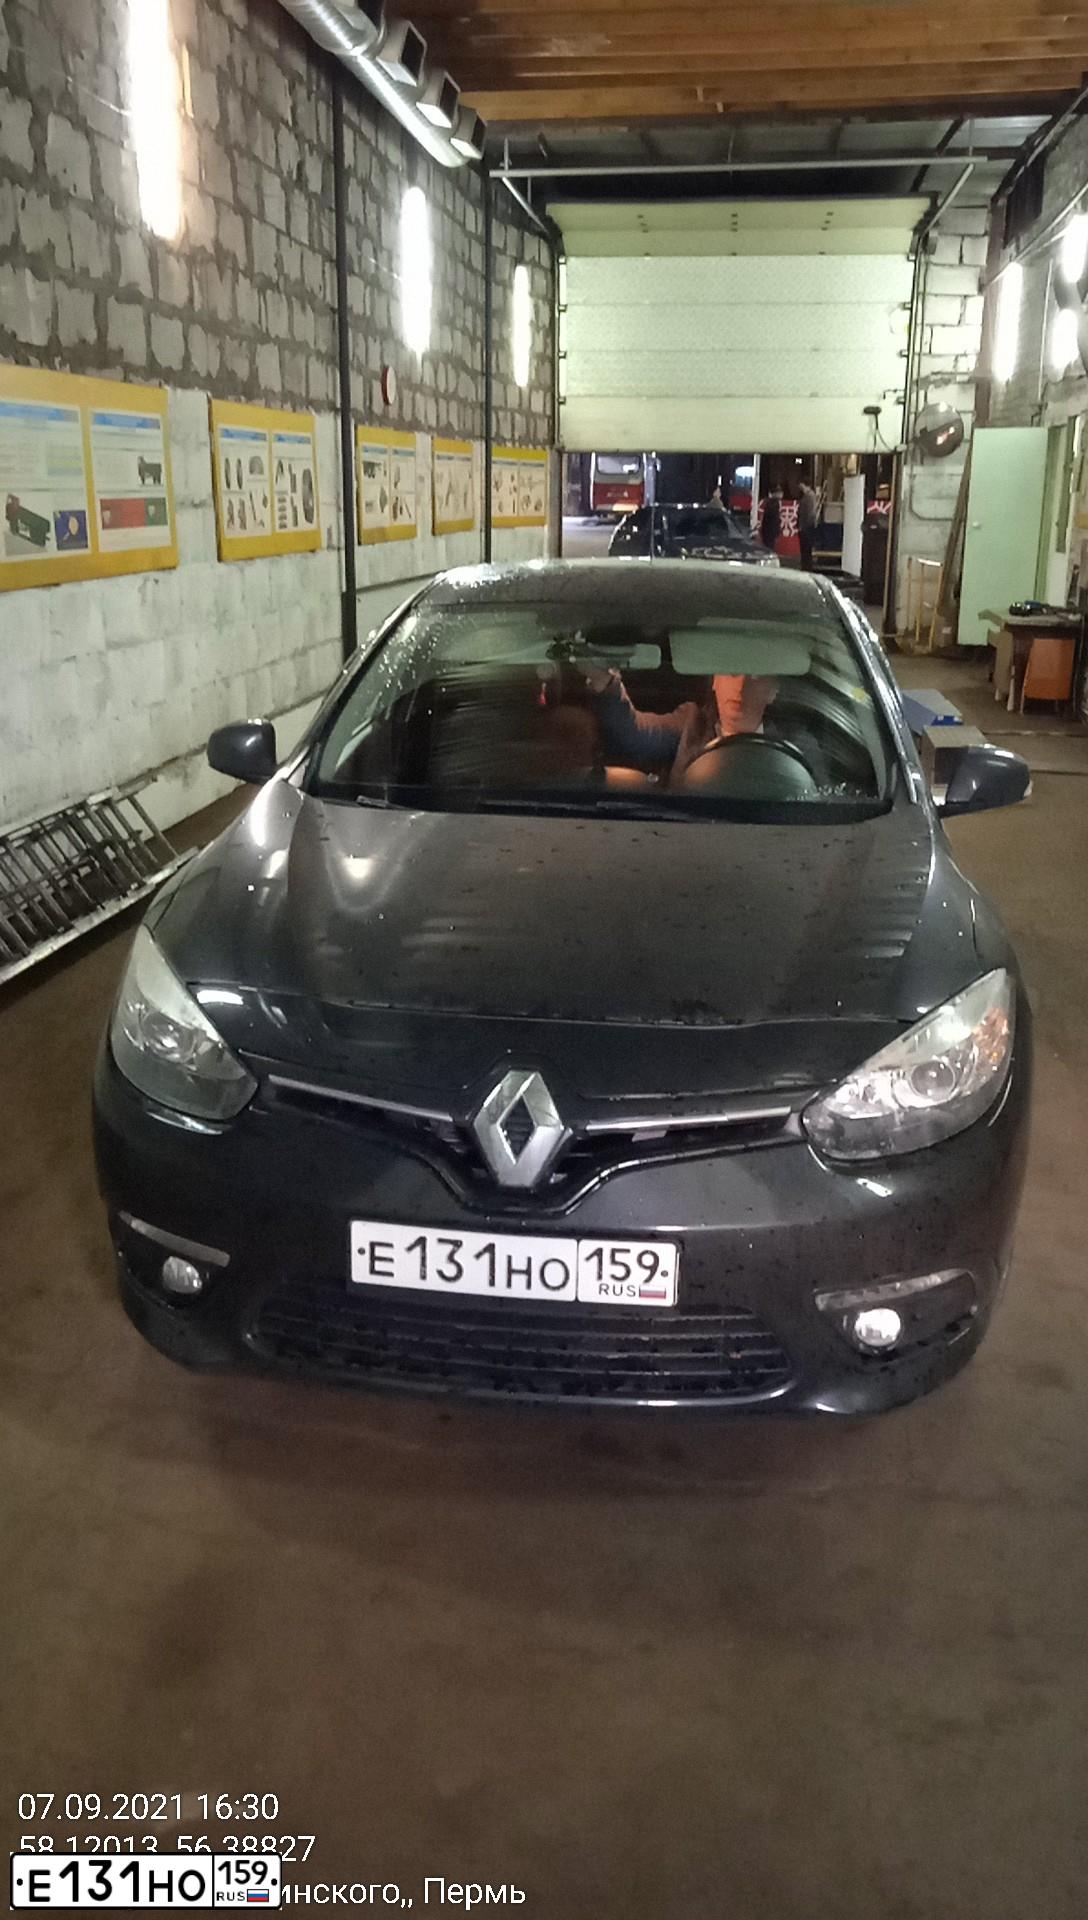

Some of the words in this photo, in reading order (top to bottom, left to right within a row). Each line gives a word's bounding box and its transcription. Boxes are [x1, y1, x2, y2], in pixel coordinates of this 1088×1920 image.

[368, 1235, 570, 1292] Е131НО
[584, 1247, 661, 1284] 159
[598, 1283, 637, 1298] RUS
